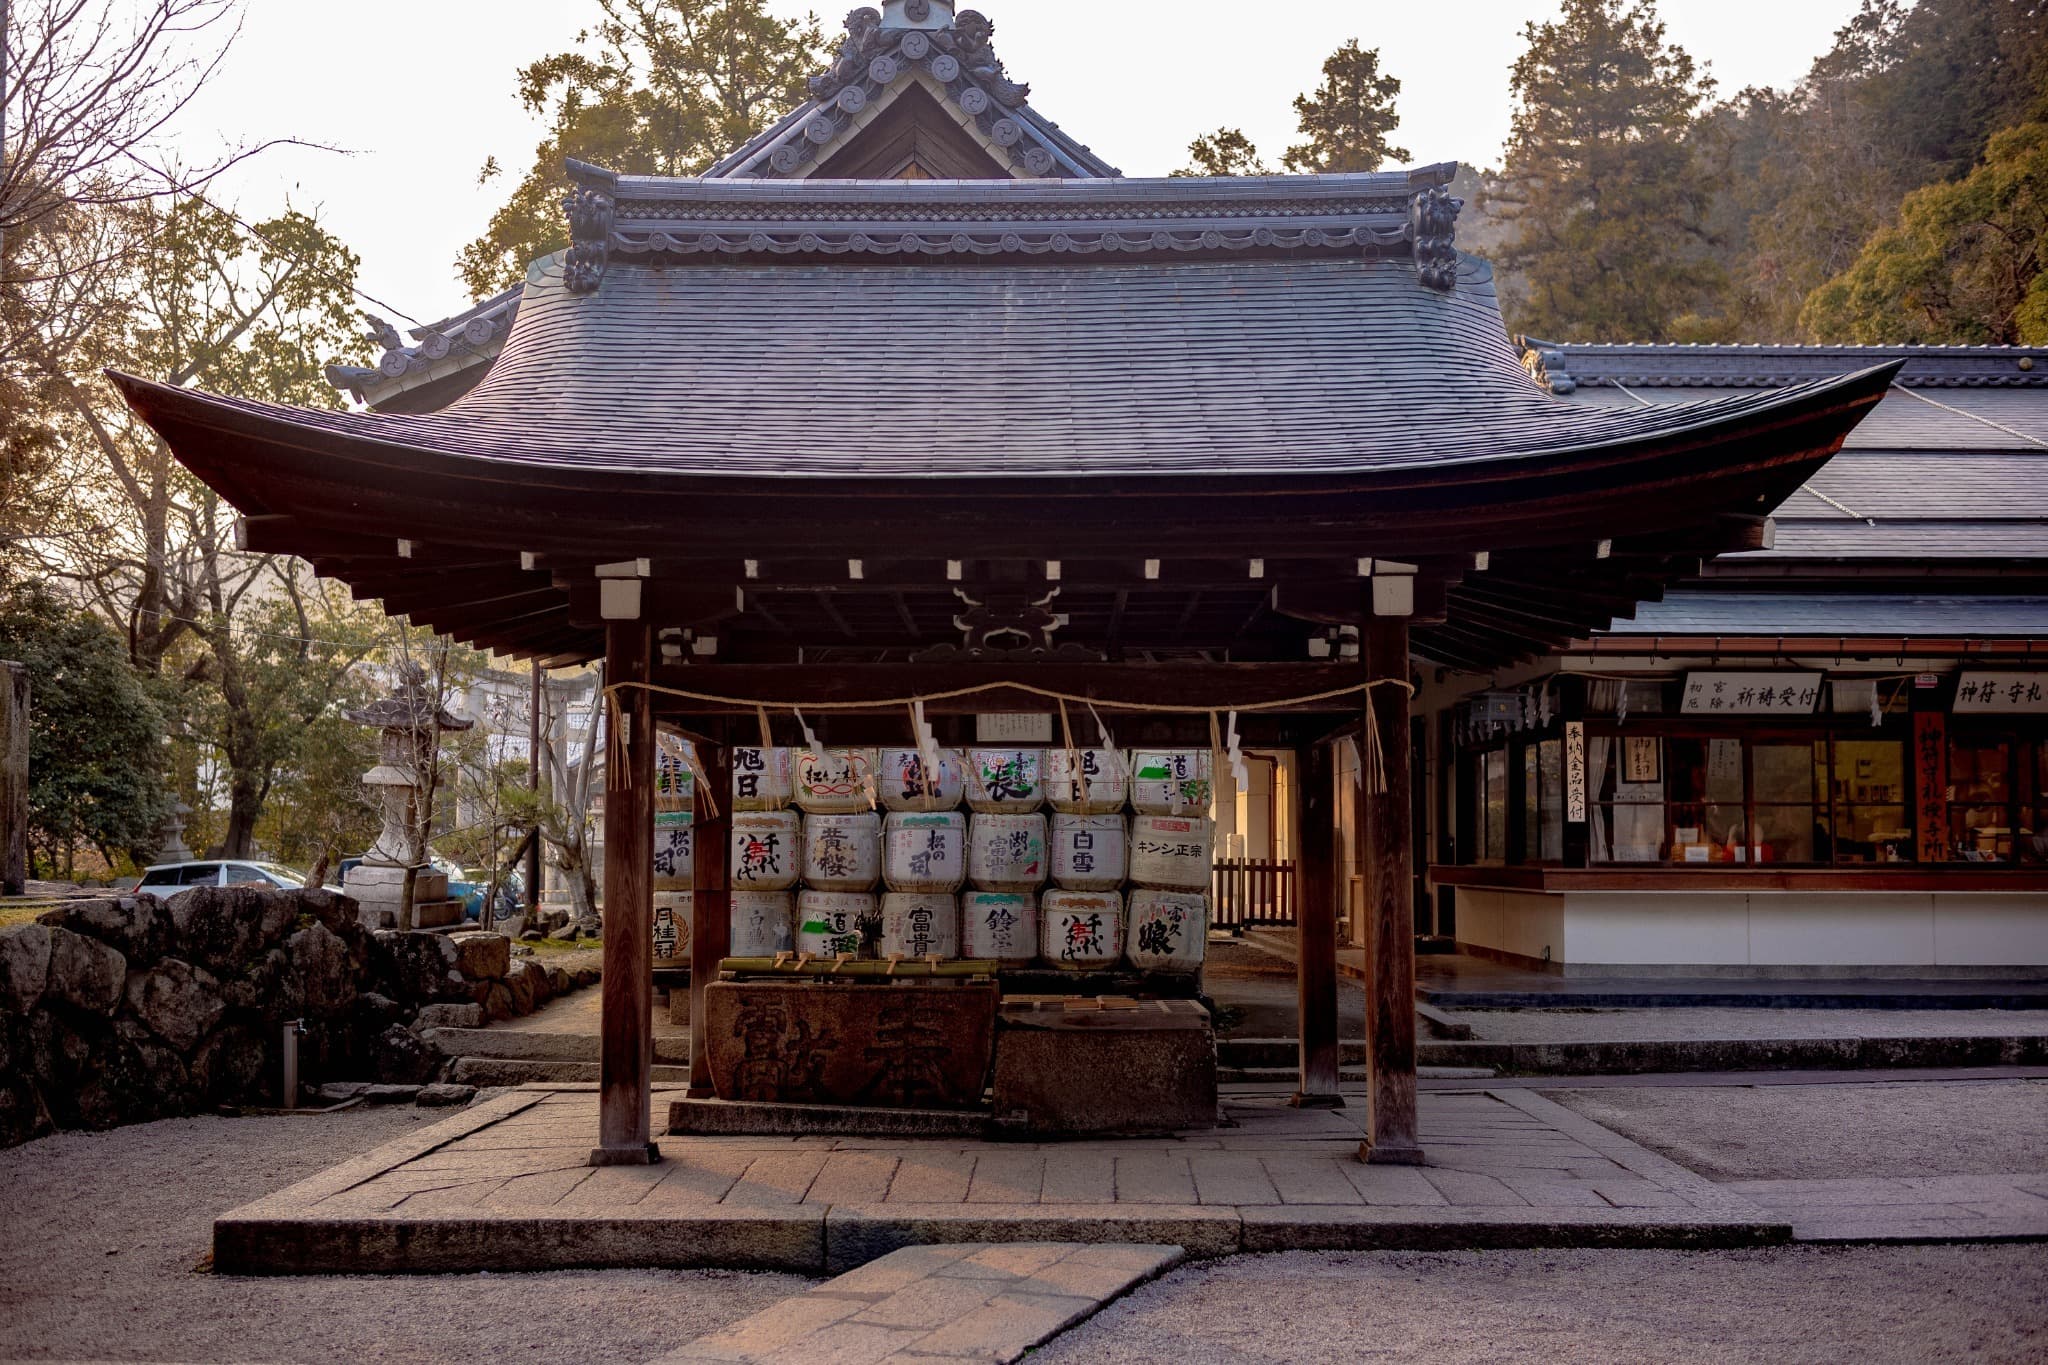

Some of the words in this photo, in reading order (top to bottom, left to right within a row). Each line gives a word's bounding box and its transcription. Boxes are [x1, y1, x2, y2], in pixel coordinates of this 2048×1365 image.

[733, 748, 765, 798] 旭日
[1568, 726, 1583, 819] 奉納金品受付
[1073, 830, 1096, 872] 白雪
[1138, 840, 1202, 858] キンシ正宗
[652, 907, 676, 959] 月桂冠
[906, 907, 936, 957] 富貴
